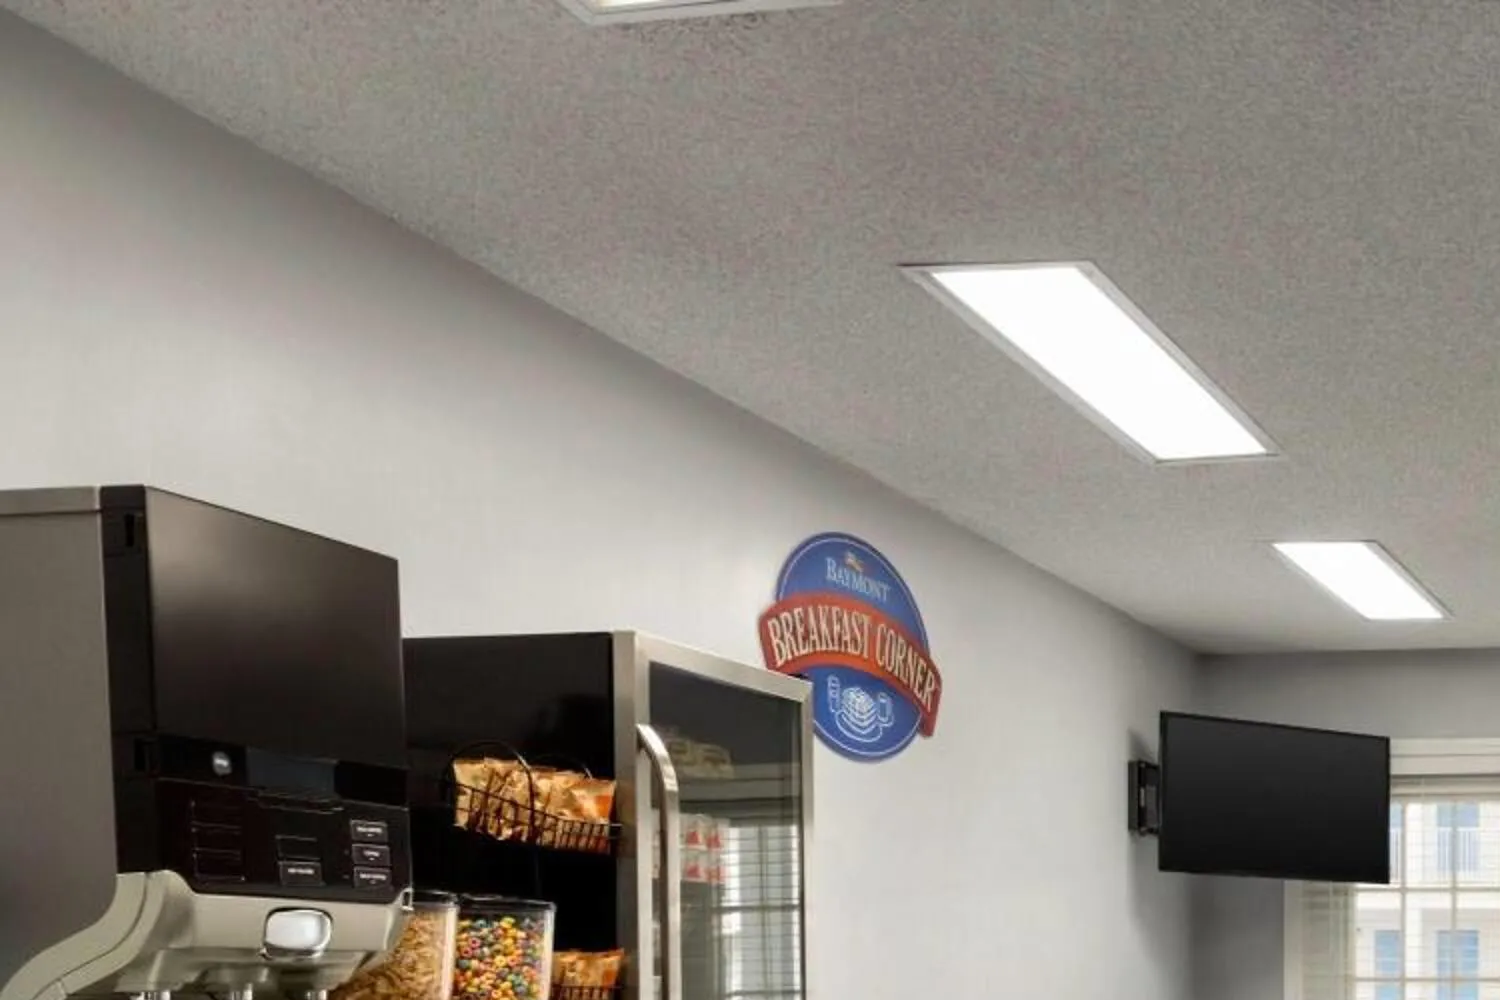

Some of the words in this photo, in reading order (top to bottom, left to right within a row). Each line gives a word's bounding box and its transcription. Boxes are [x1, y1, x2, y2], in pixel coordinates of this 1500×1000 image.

[826, 557, 890, 603] BAYMONT
[768, 604, 871, 667] BREAKFAST
[875, 623, 936, 712] CORNER
